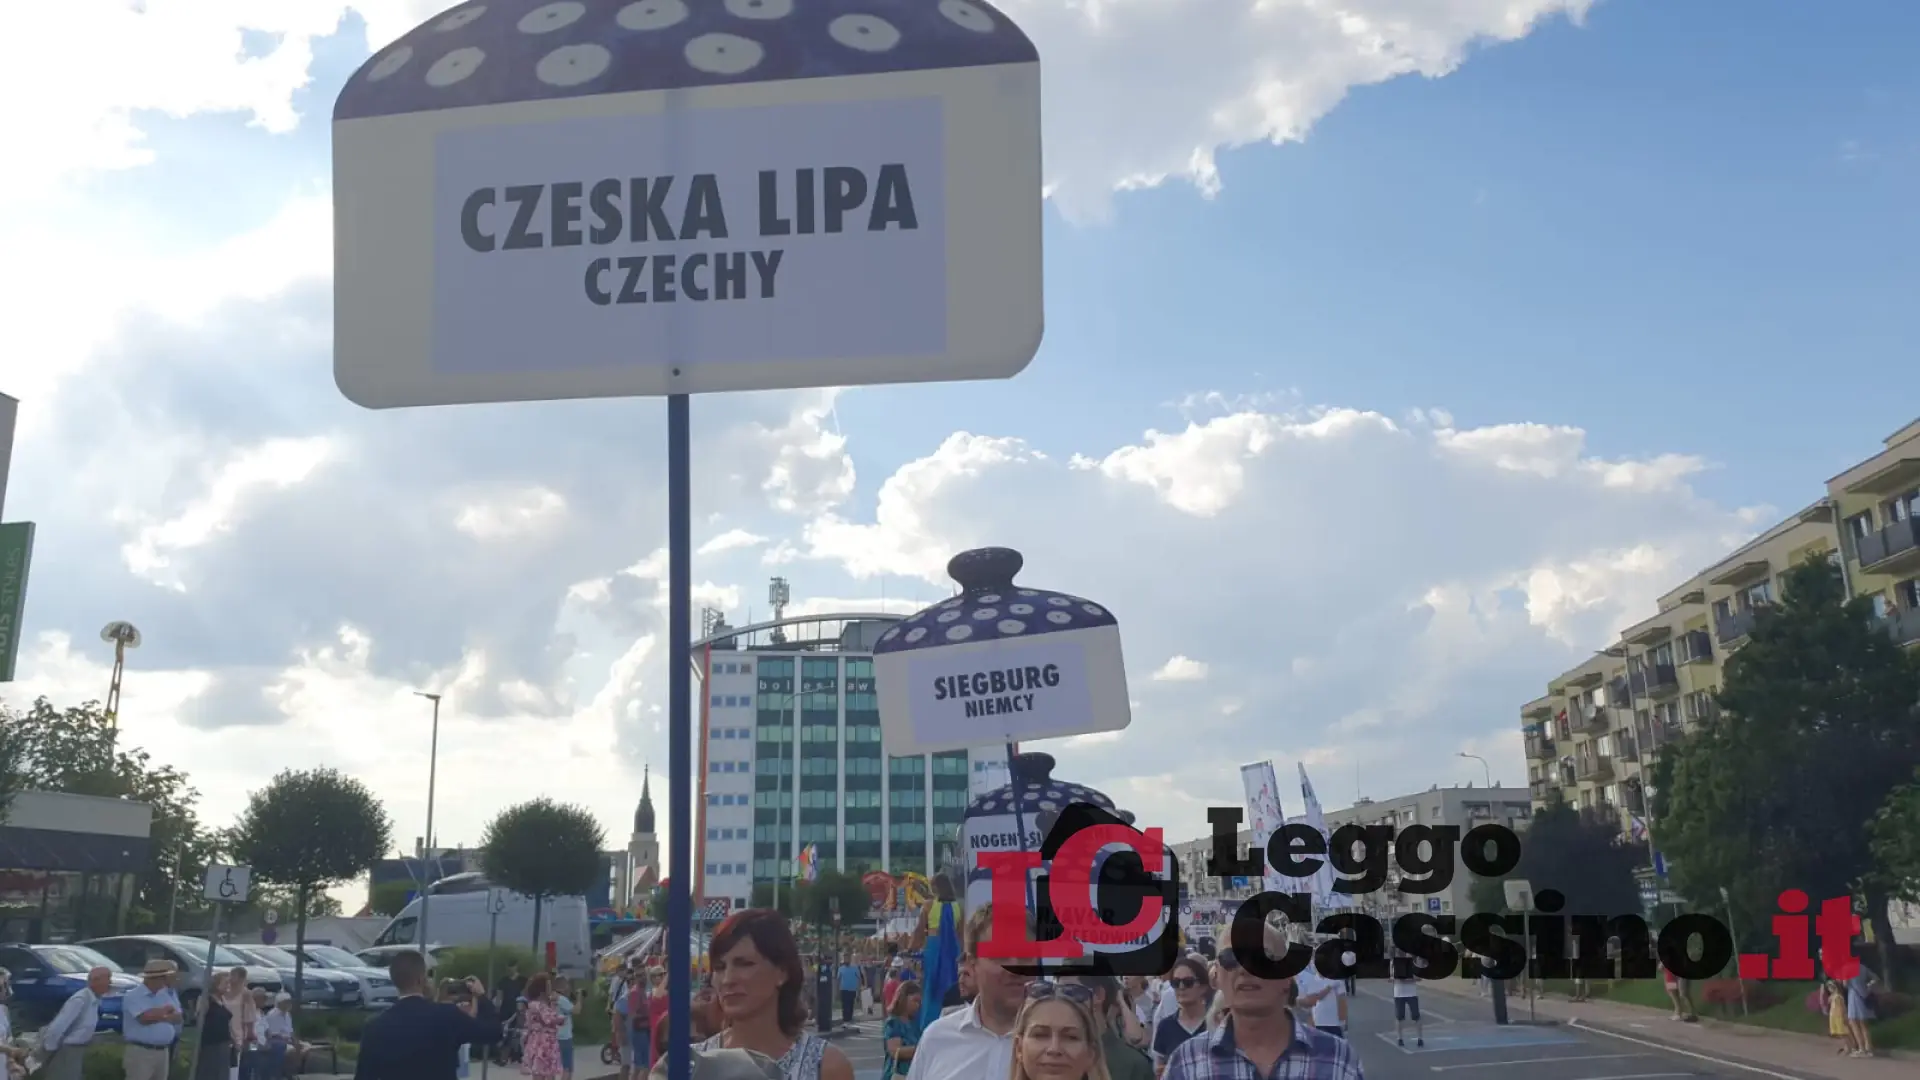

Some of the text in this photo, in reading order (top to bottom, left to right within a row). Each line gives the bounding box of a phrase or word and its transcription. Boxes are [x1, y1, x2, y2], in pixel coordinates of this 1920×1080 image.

[460, 163, 919, 252] CZESKA LIPA
[584, 249, 785, 306] CZECHY
[934, 664, 1060, 701] SIEGBURG
[964, 694, 1034, 719] NIEMCY
